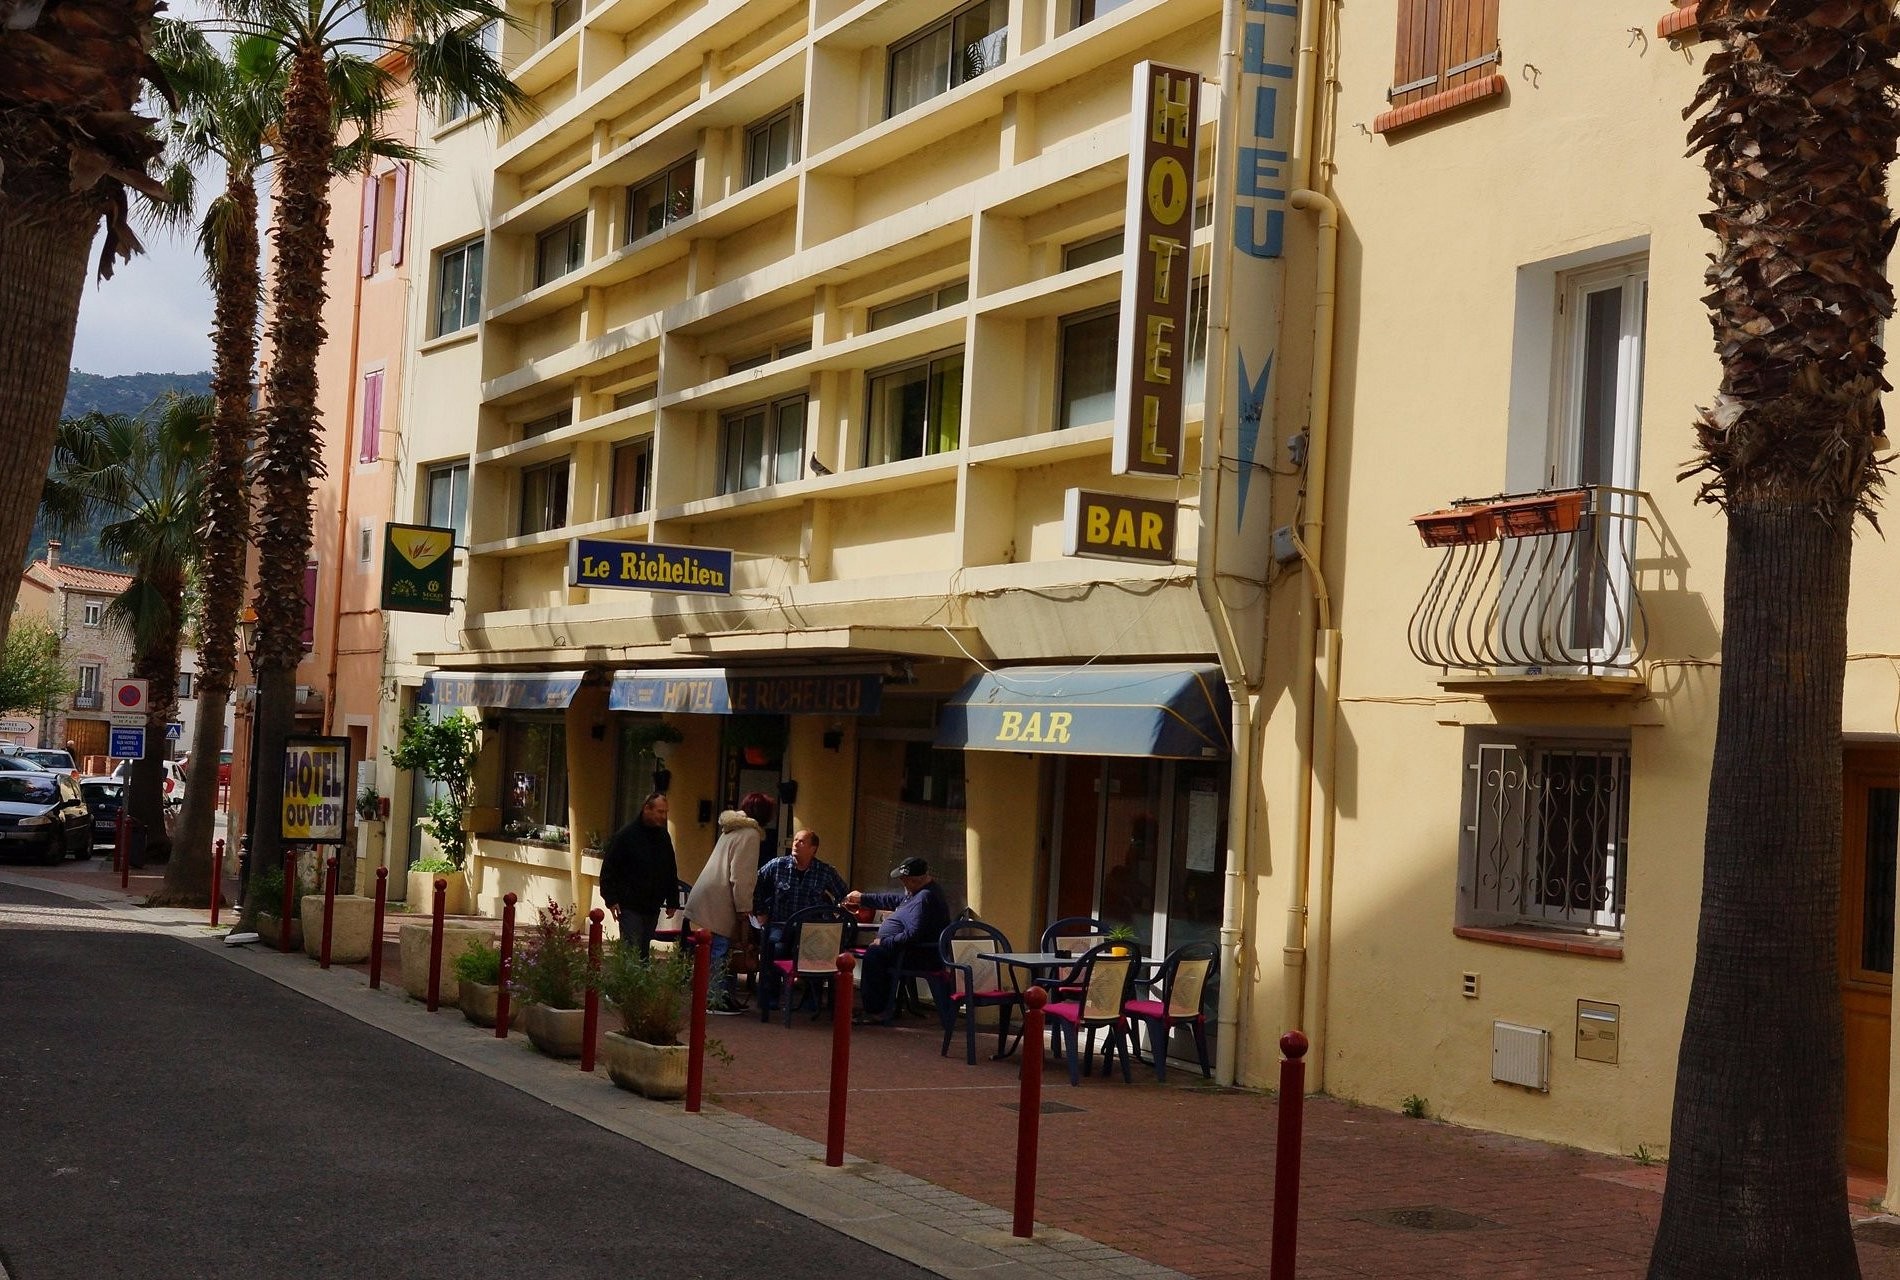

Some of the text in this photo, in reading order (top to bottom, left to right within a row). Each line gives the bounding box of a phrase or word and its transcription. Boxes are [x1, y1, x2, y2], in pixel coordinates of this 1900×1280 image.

[1235, 0, 1297, 260] LIEU
[1140, 72, 1191, 466] HOTEL
[1086, 505, 1163, 550] BAR
[582, 552, 724, 586] Le Richelieu
[439, 680, 453, 703] LE
[663, 680, 714, 709] HOTEL
[727, 680, 749, 710] LE
[755, 680, 861, 710] RICHELIEU
[995, 711, 1072, 744] BAR
[285, 750, 341, 799] HOTEL
[286, 803, 340, 827] OUVERT
